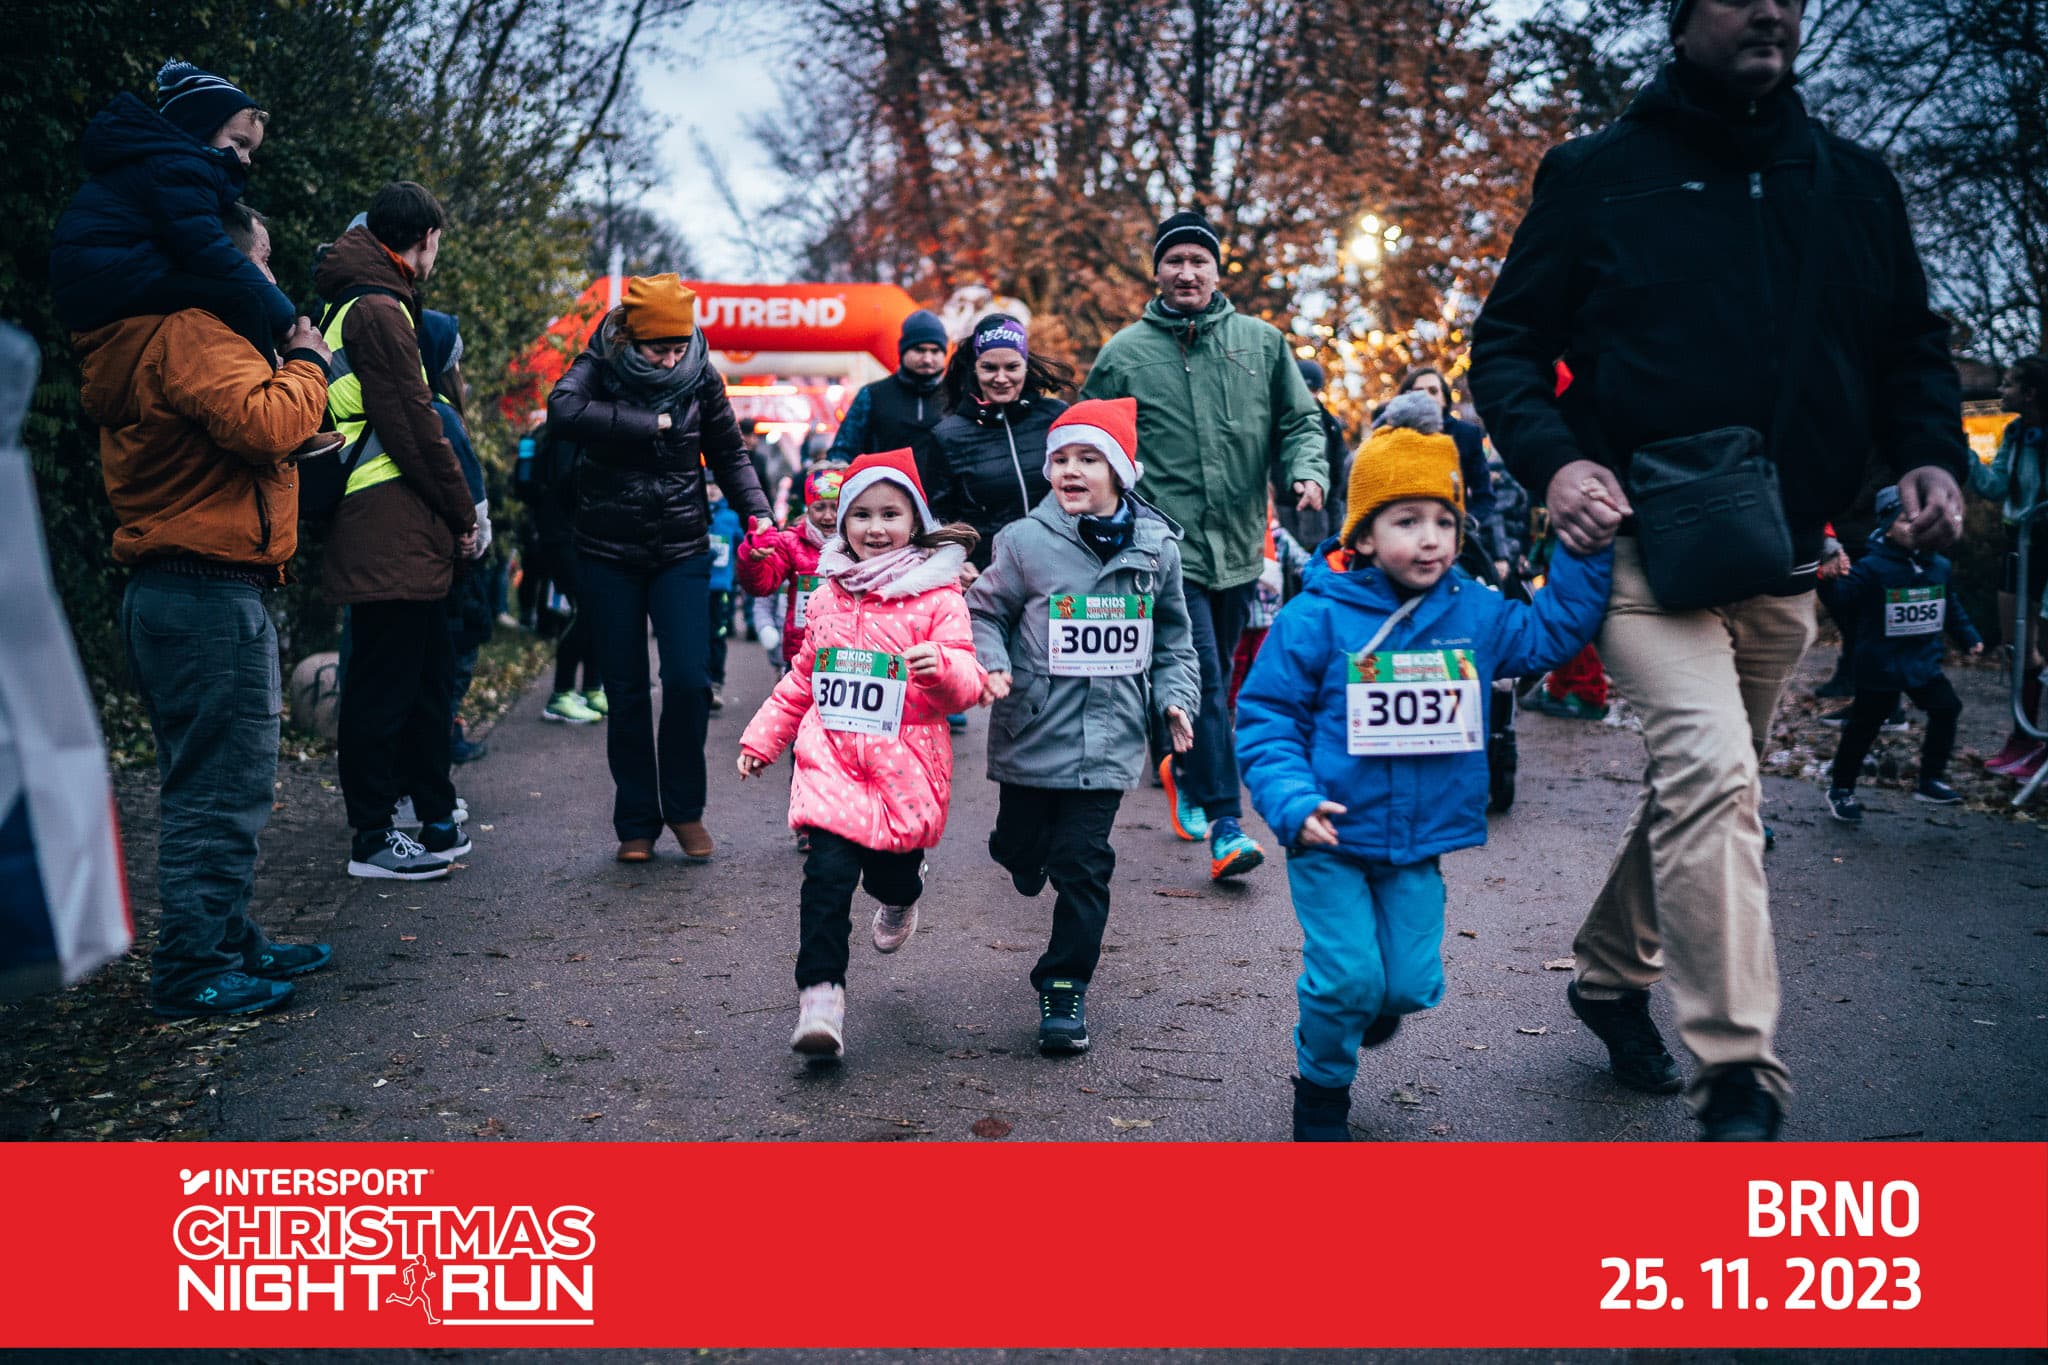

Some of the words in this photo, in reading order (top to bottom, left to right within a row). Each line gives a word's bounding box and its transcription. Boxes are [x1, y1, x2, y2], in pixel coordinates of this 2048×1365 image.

[692, 296, 846, 328] UTREND
[1894, 603, 1938, 624] 3056
[1061, 626, 1139, 654] 3009
[848, 650, 873, 664] KIDS
[818, 678, 884, 711] 3010
[1367, 689, 1462, 726] 3037
